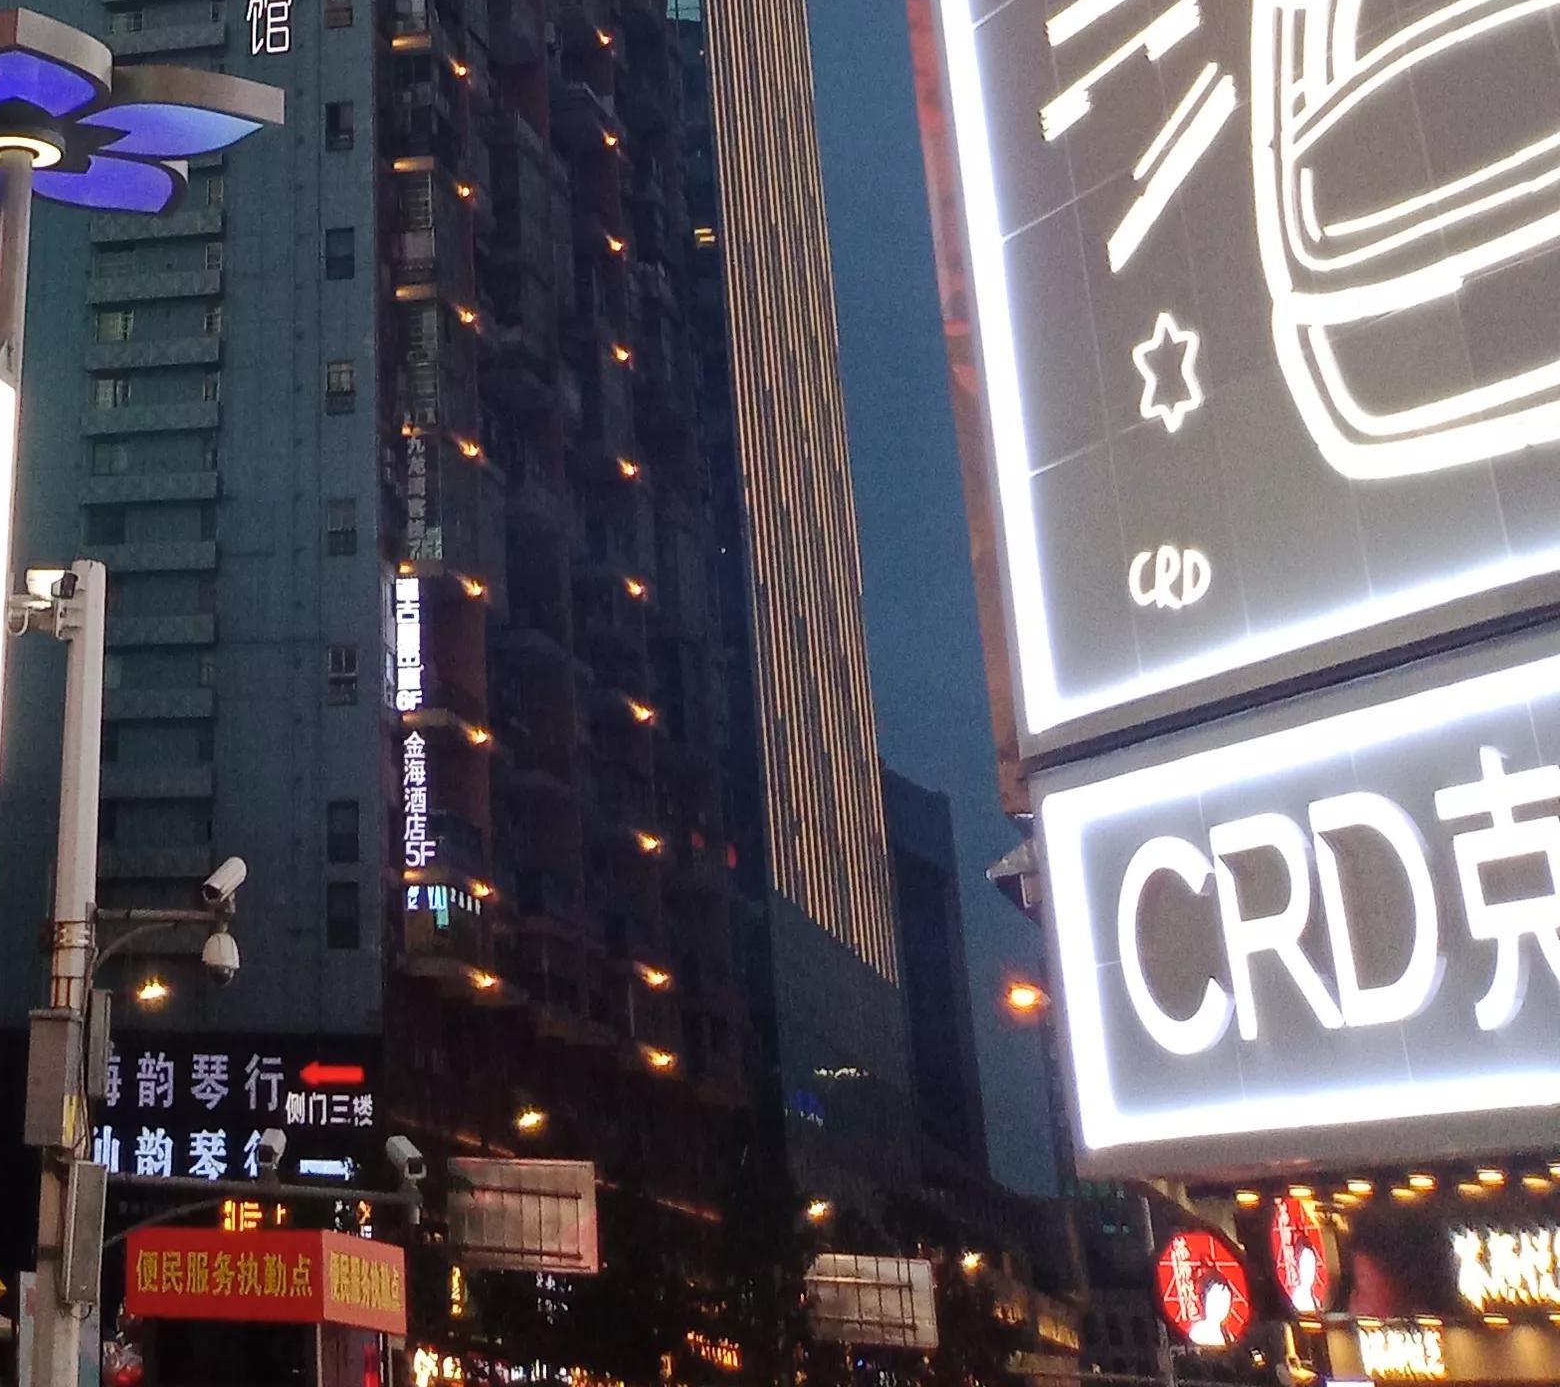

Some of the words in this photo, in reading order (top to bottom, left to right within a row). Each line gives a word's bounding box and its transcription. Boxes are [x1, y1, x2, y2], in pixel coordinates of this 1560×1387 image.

[1127, 543, 1212, 610] CRD
[403, 731, 437, 867] 金海酒店5F
[285, 1091, 374, 1127] 侧门三楼
[135, 1249, 313, 1298] 便民服务执勤点
